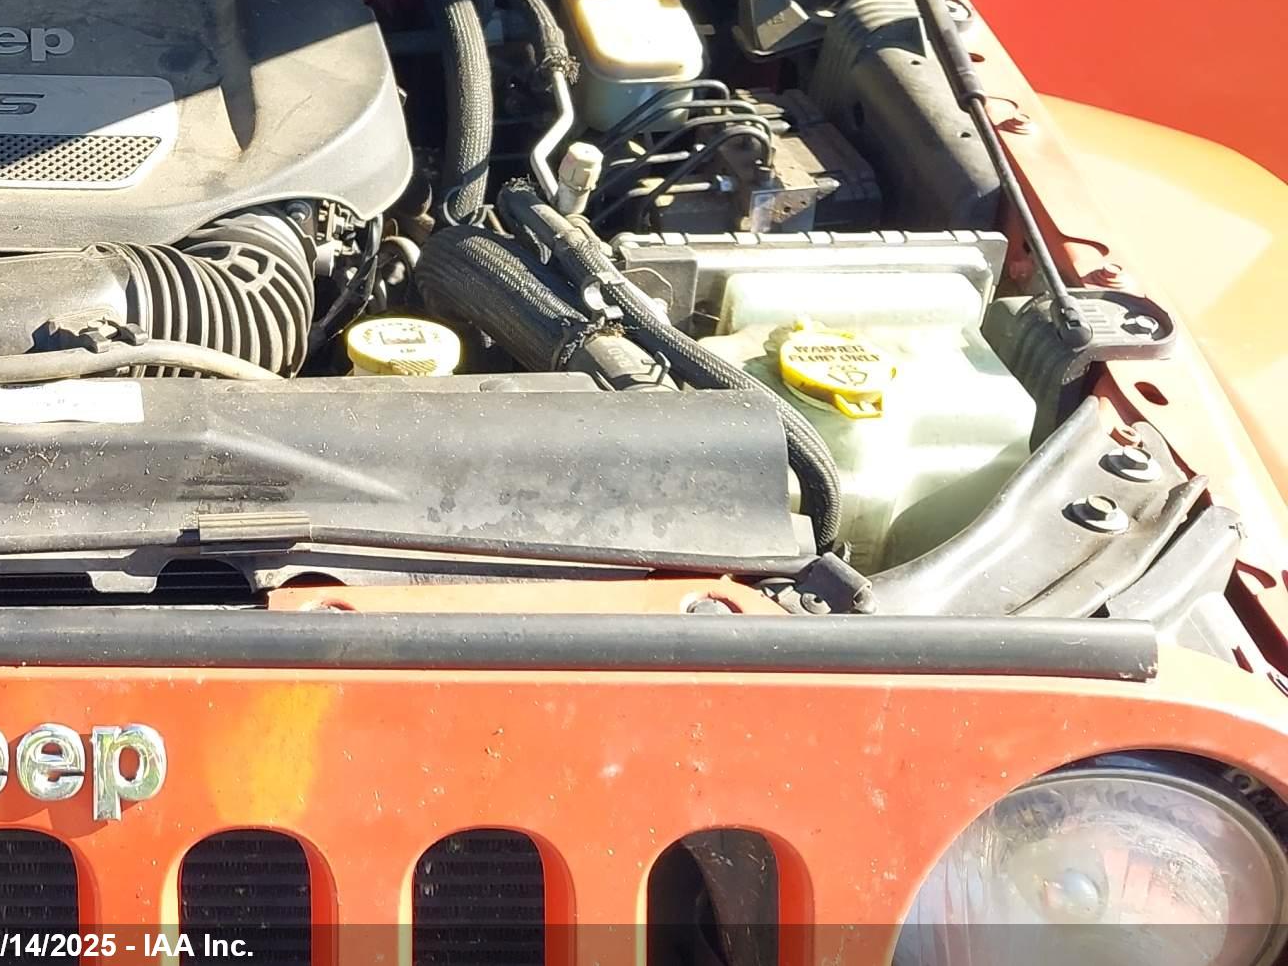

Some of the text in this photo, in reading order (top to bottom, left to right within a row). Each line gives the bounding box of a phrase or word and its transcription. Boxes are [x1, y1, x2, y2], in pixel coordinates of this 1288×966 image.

[793, 345, 865, 353] WASHER
[788, 354, 880, 362] FLUID ONLY
